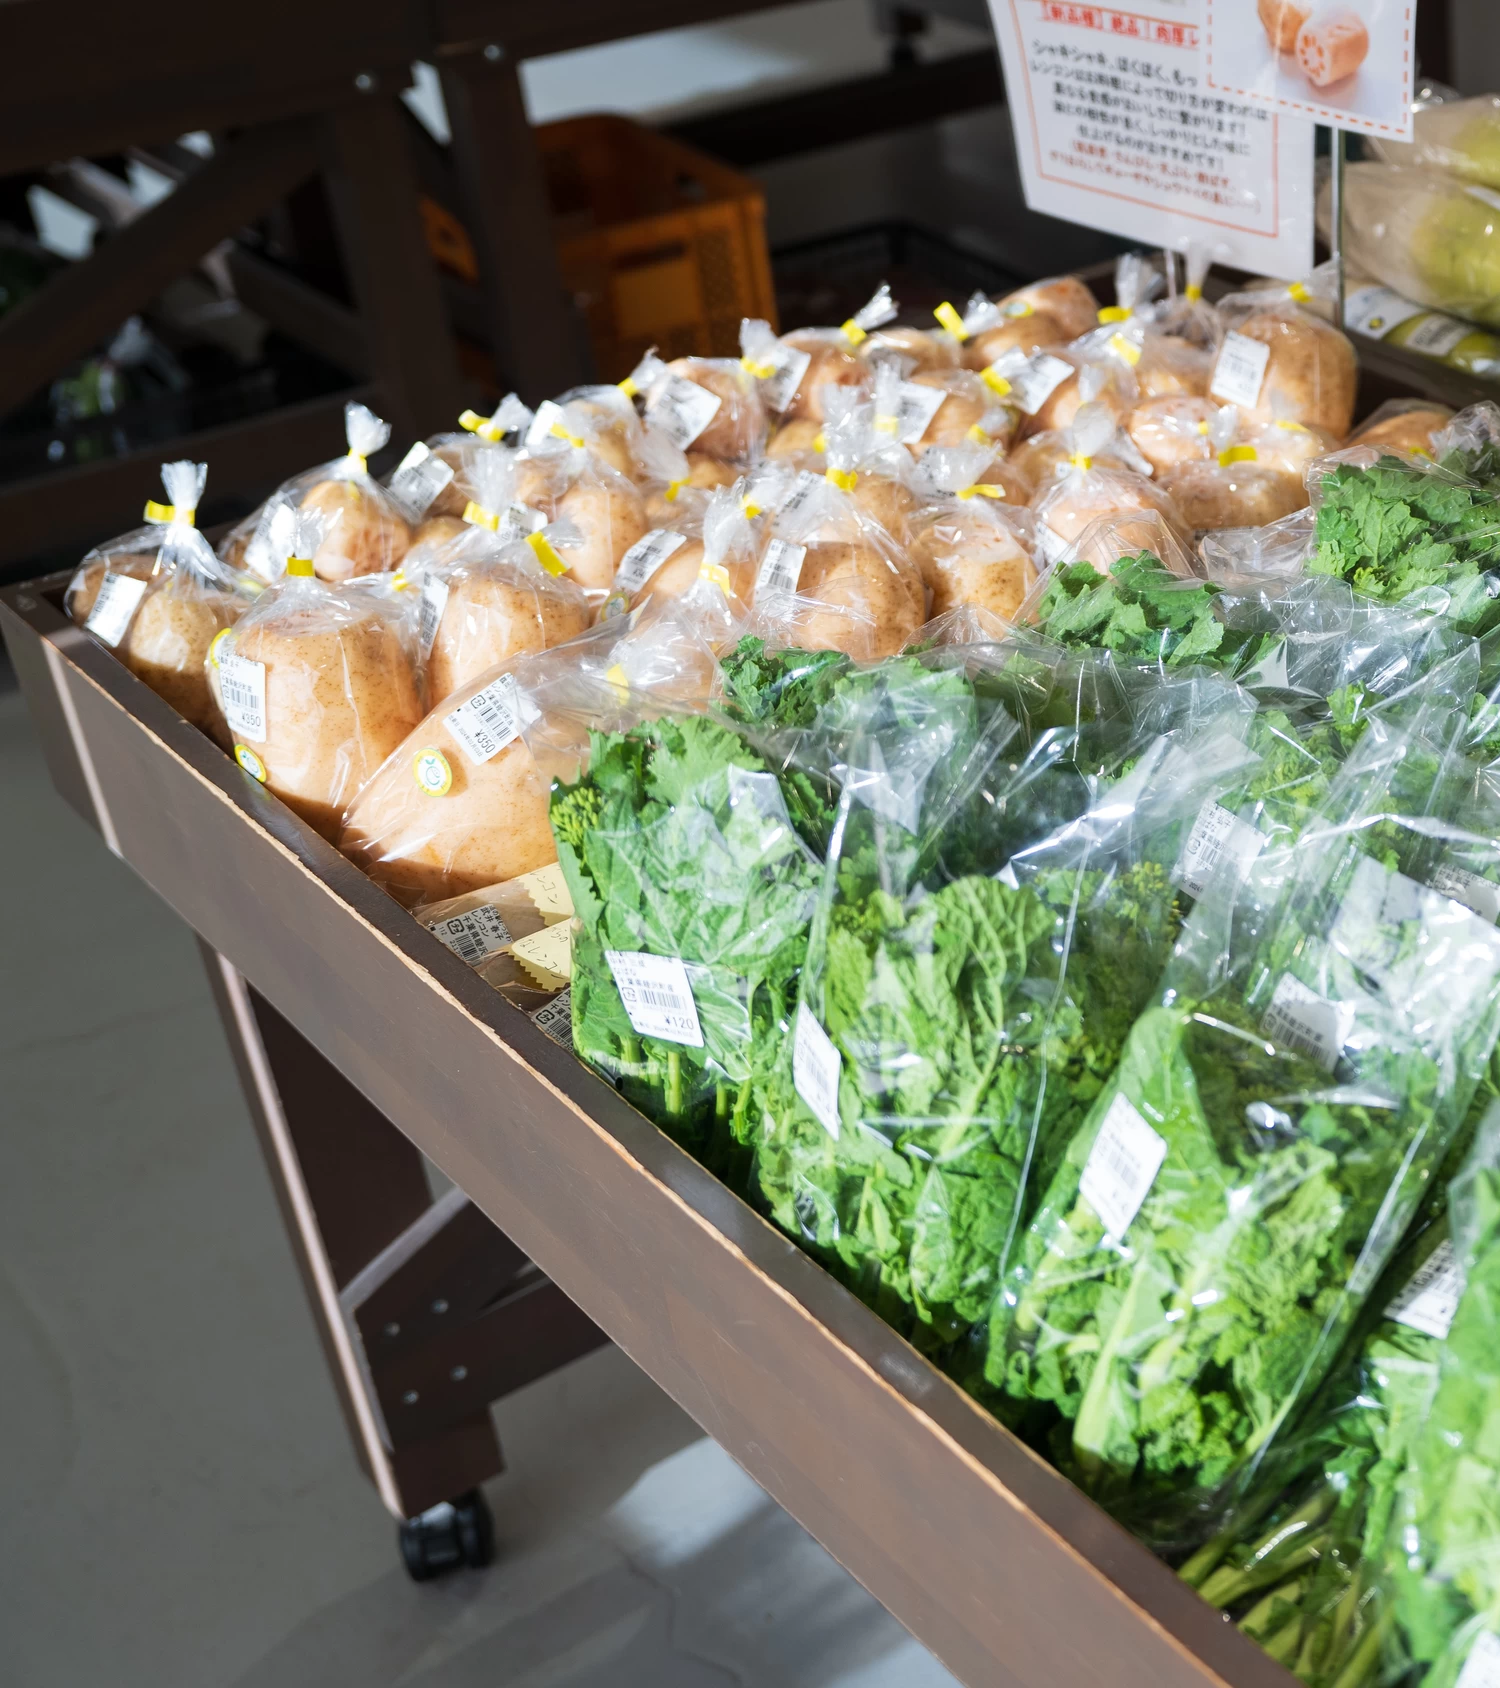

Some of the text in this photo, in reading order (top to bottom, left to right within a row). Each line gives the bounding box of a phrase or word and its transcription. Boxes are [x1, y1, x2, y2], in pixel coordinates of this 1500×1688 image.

[241, 712, 261, 727] ¥350
[474, 729, 496, 754] ¥350
[439, 926, 448, 936] 112
[471, 910, 489, 937] レンコン
[481, 907, 505, 941] 武井 春子
[664, 1015, 694, 1030] ¥120
